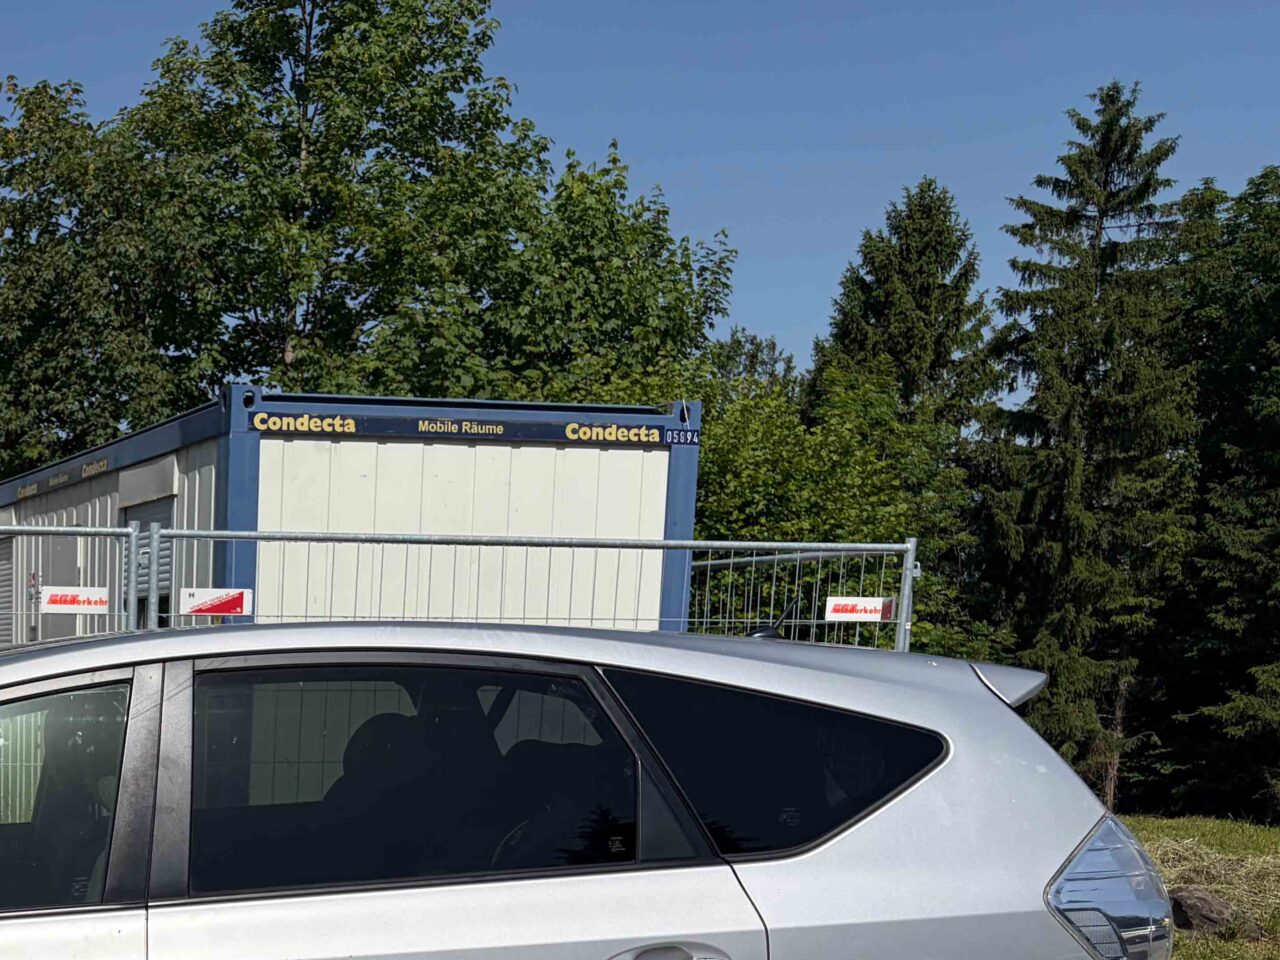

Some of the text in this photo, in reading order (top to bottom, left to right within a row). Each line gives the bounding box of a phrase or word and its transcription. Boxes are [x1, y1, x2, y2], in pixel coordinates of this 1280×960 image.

[253, 413, 660, 443] Condecta Mobile Räume Condecta
[666, 431, 698, 444] 05894
